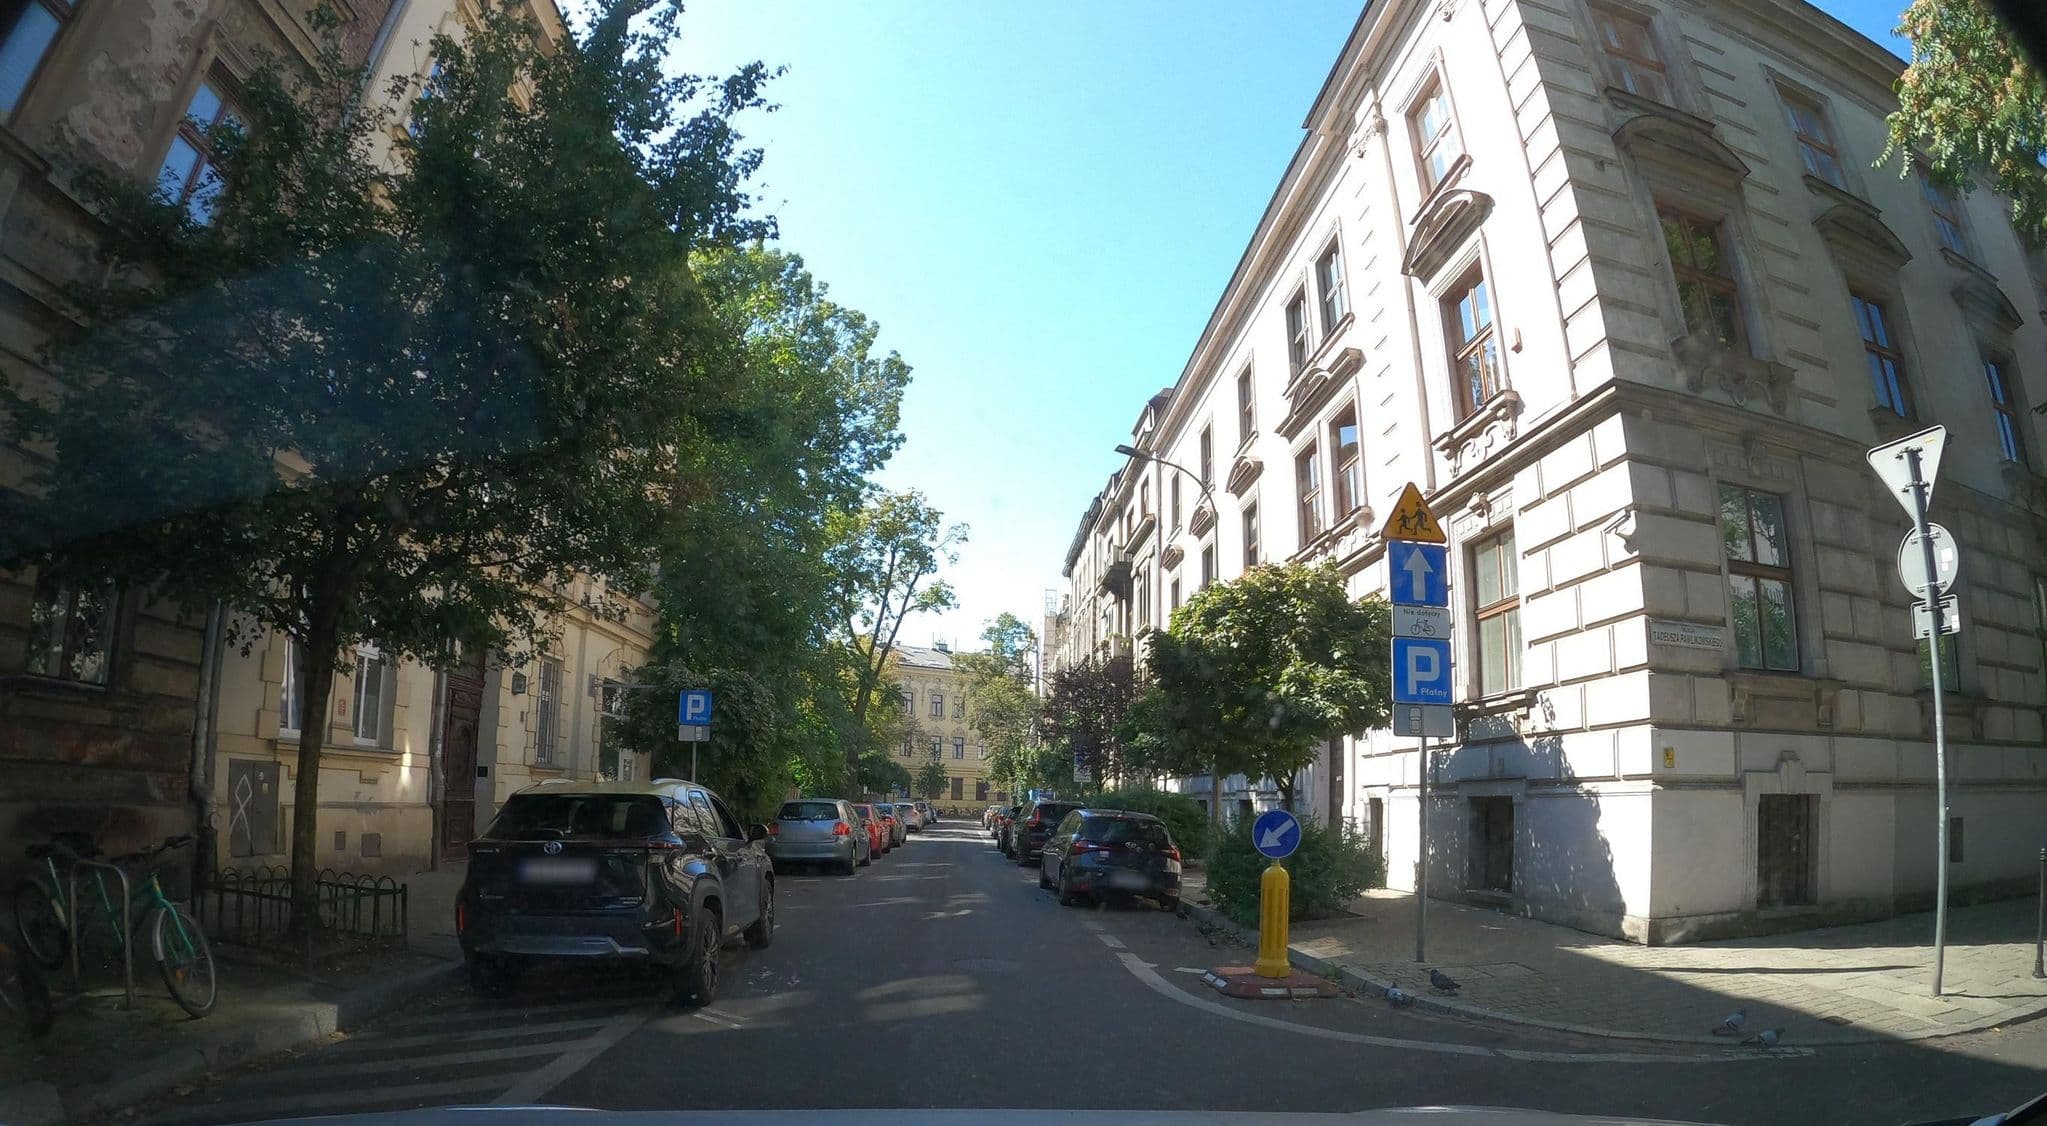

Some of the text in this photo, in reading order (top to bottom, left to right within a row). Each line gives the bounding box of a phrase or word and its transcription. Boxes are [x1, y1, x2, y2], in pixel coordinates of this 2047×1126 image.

[1403, 608, 1440, 618] Nie dotyczy
[1407, 646, 1440, 695] P
[1420, 687, 1448, 698] Płatny
[686, 694, 705, 721] P
